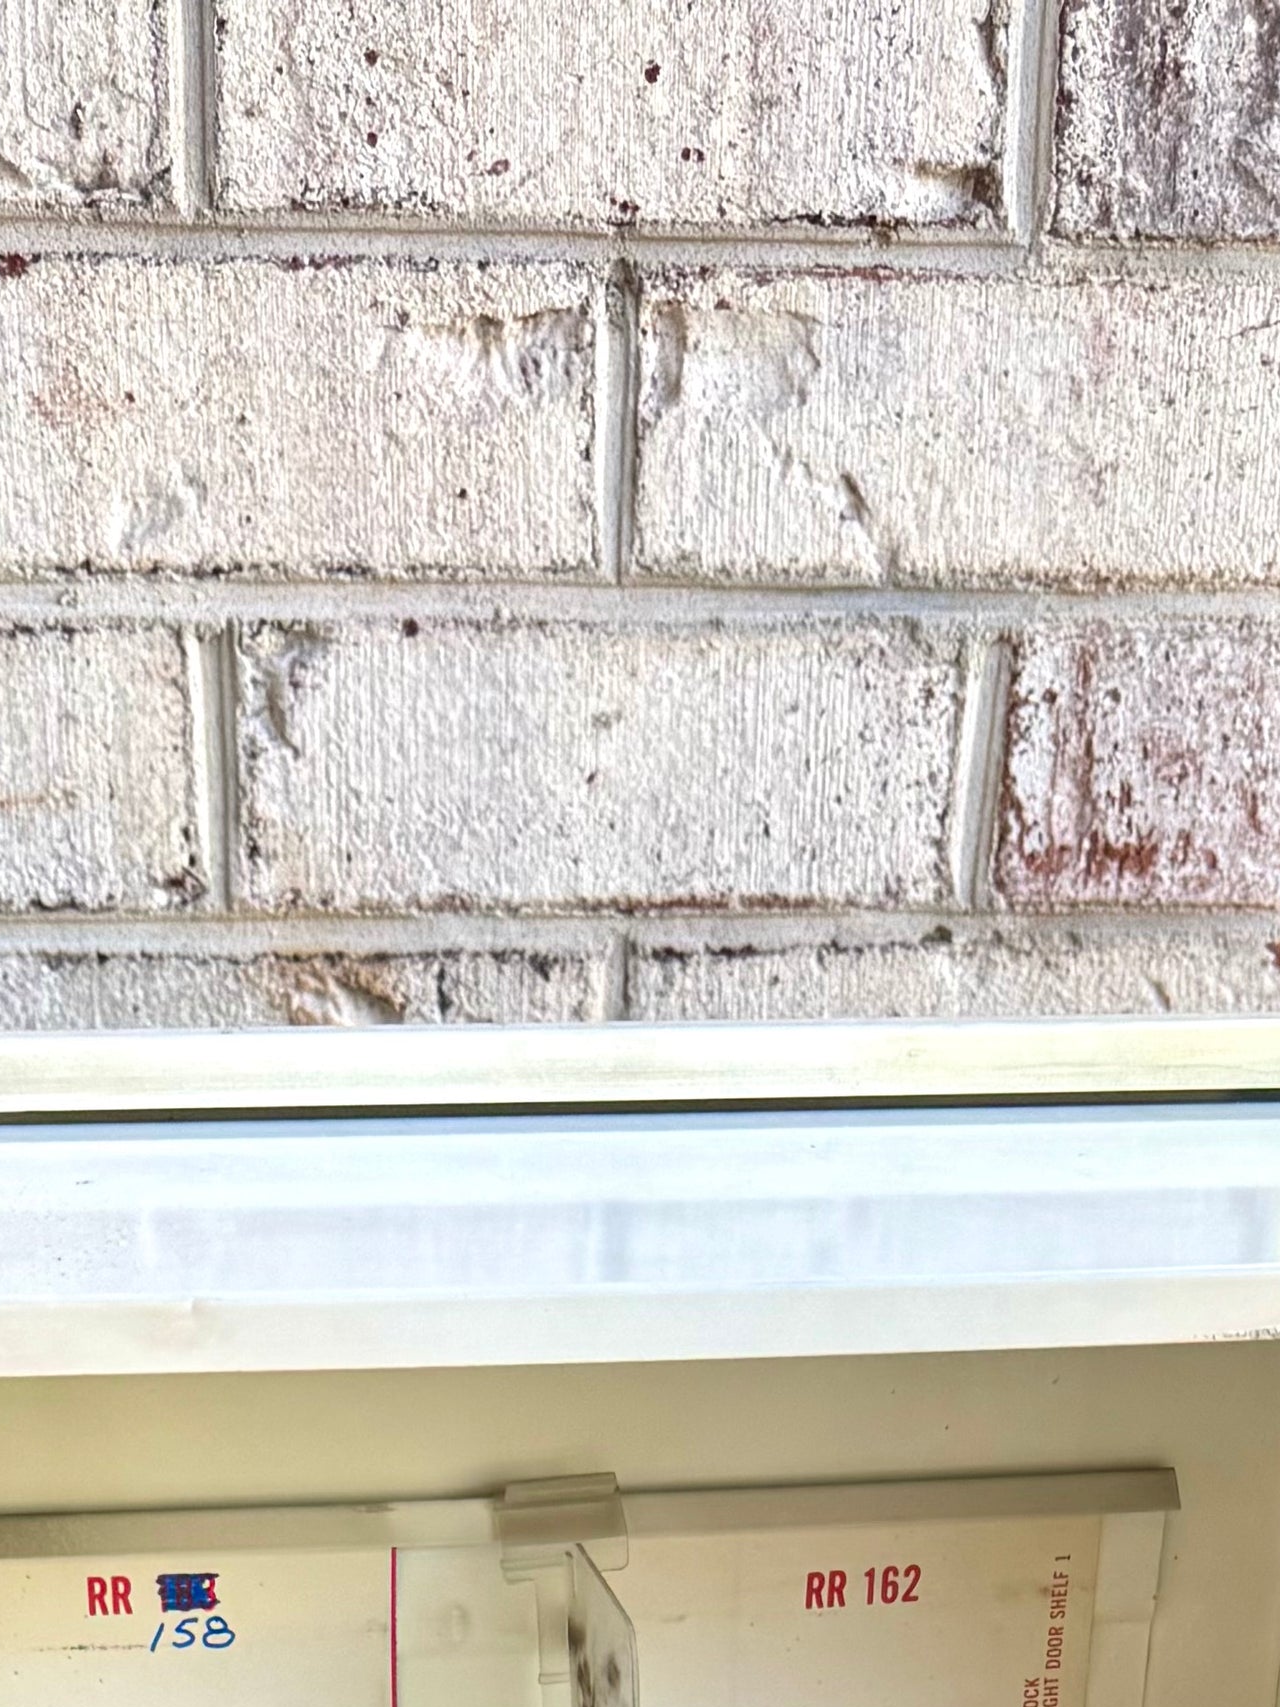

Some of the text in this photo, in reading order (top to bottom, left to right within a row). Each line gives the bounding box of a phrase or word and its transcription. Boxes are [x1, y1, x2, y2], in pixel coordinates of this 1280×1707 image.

[86, 1576, 133, 1616] RR
[805, 1564, 922, 1609] RR 162
[1049, 1571, 1069, 1619] SHELF
[150, 1615, 237, 1653] 158
[1045, 1626, 1064, 1670] DOOR
